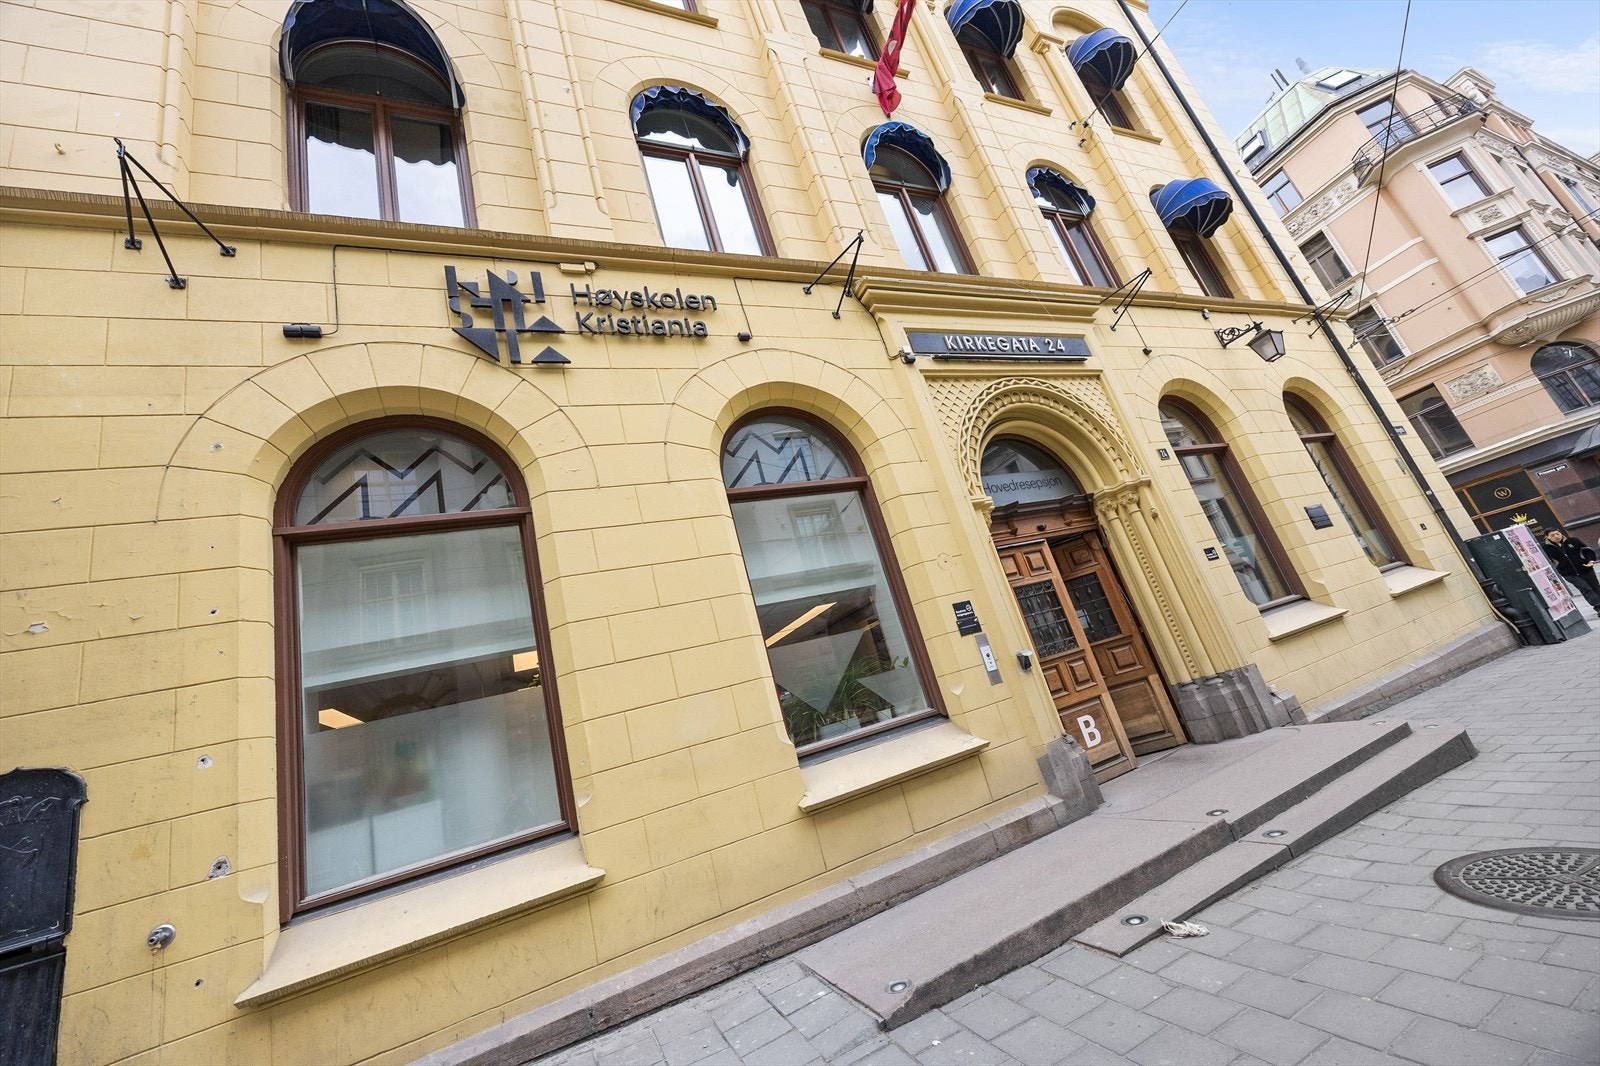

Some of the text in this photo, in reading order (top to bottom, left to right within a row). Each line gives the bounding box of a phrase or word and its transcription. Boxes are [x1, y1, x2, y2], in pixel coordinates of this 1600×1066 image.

[569, 282, 718, 312] Høyskolen
[575, 311, 709, 338] Kristiania
[944, 335, 1066, 353] KIRKEGATA 24
[1159, 449, 1168, 458] 24
[983, 476, 1063, 494] Hovedresepsjon
[1076, 714, 1102, 749] B
